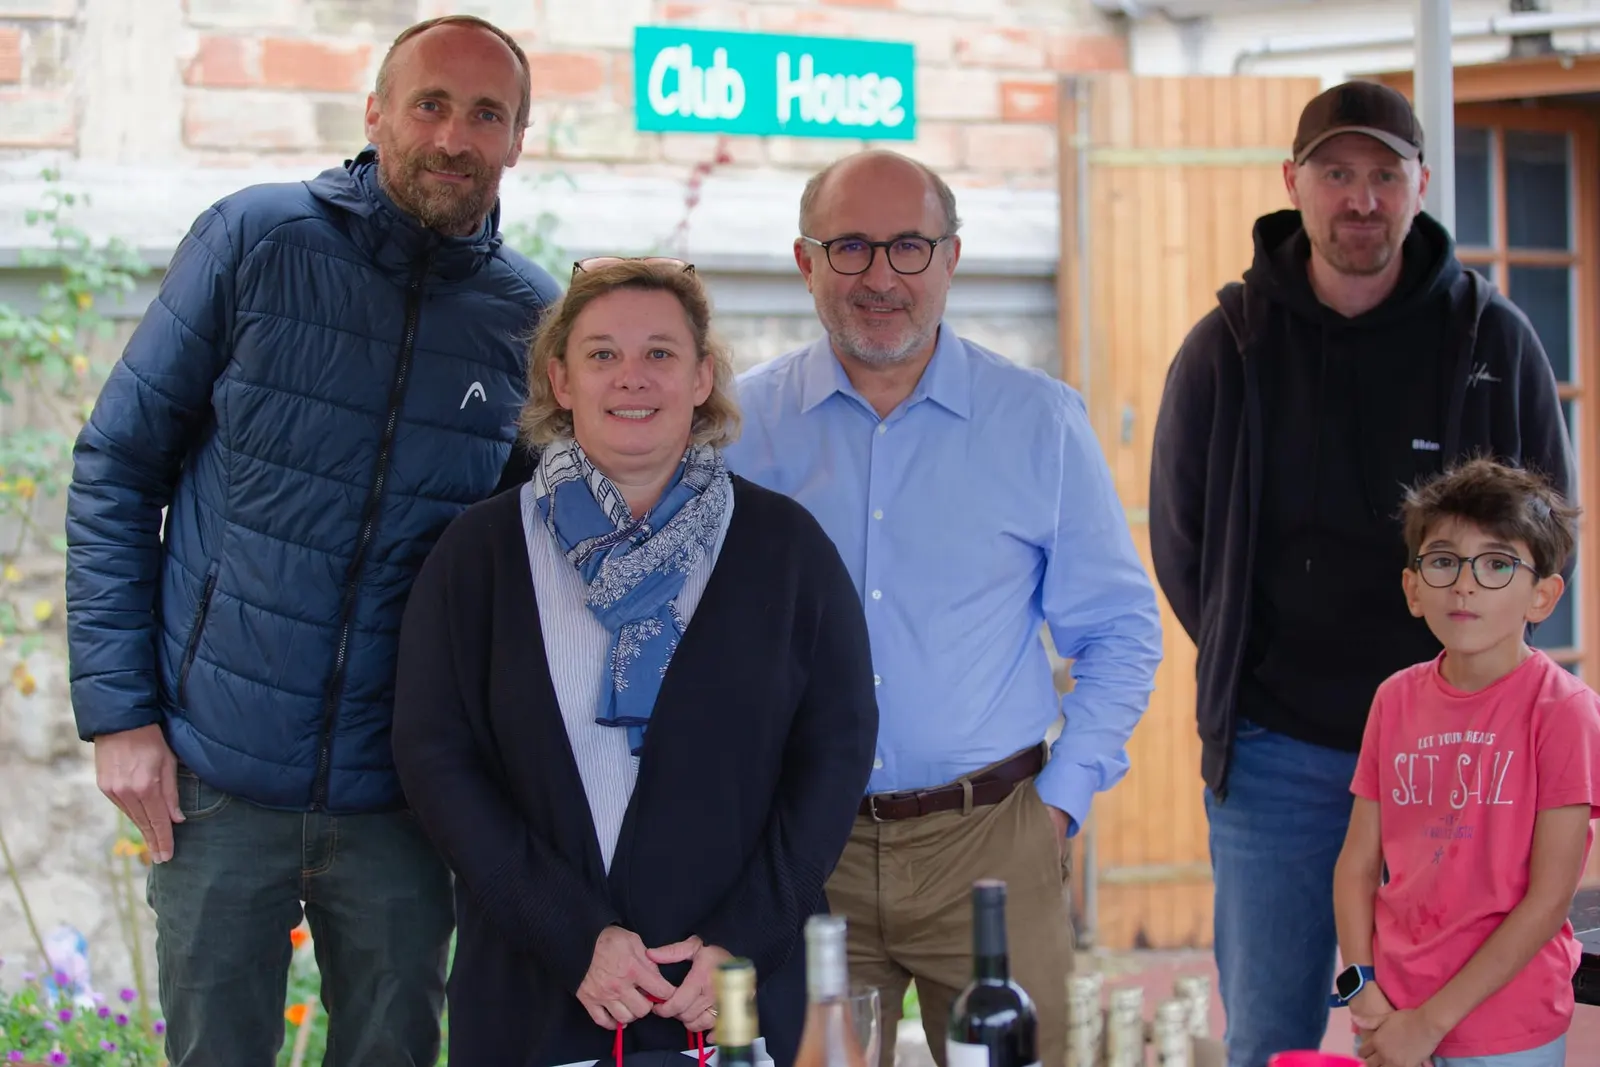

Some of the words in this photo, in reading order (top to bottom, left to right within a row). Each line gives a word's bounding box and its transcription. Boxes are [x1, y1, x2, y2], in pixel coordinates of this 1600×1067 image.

[648, 43, 746, 120] Club
[776, 51, 905, 127] House
[1417, 735, 1434, 750] LET
[1392, 752, 1440, 806] SET
[1450, 750, 1515, 810] SAIL
